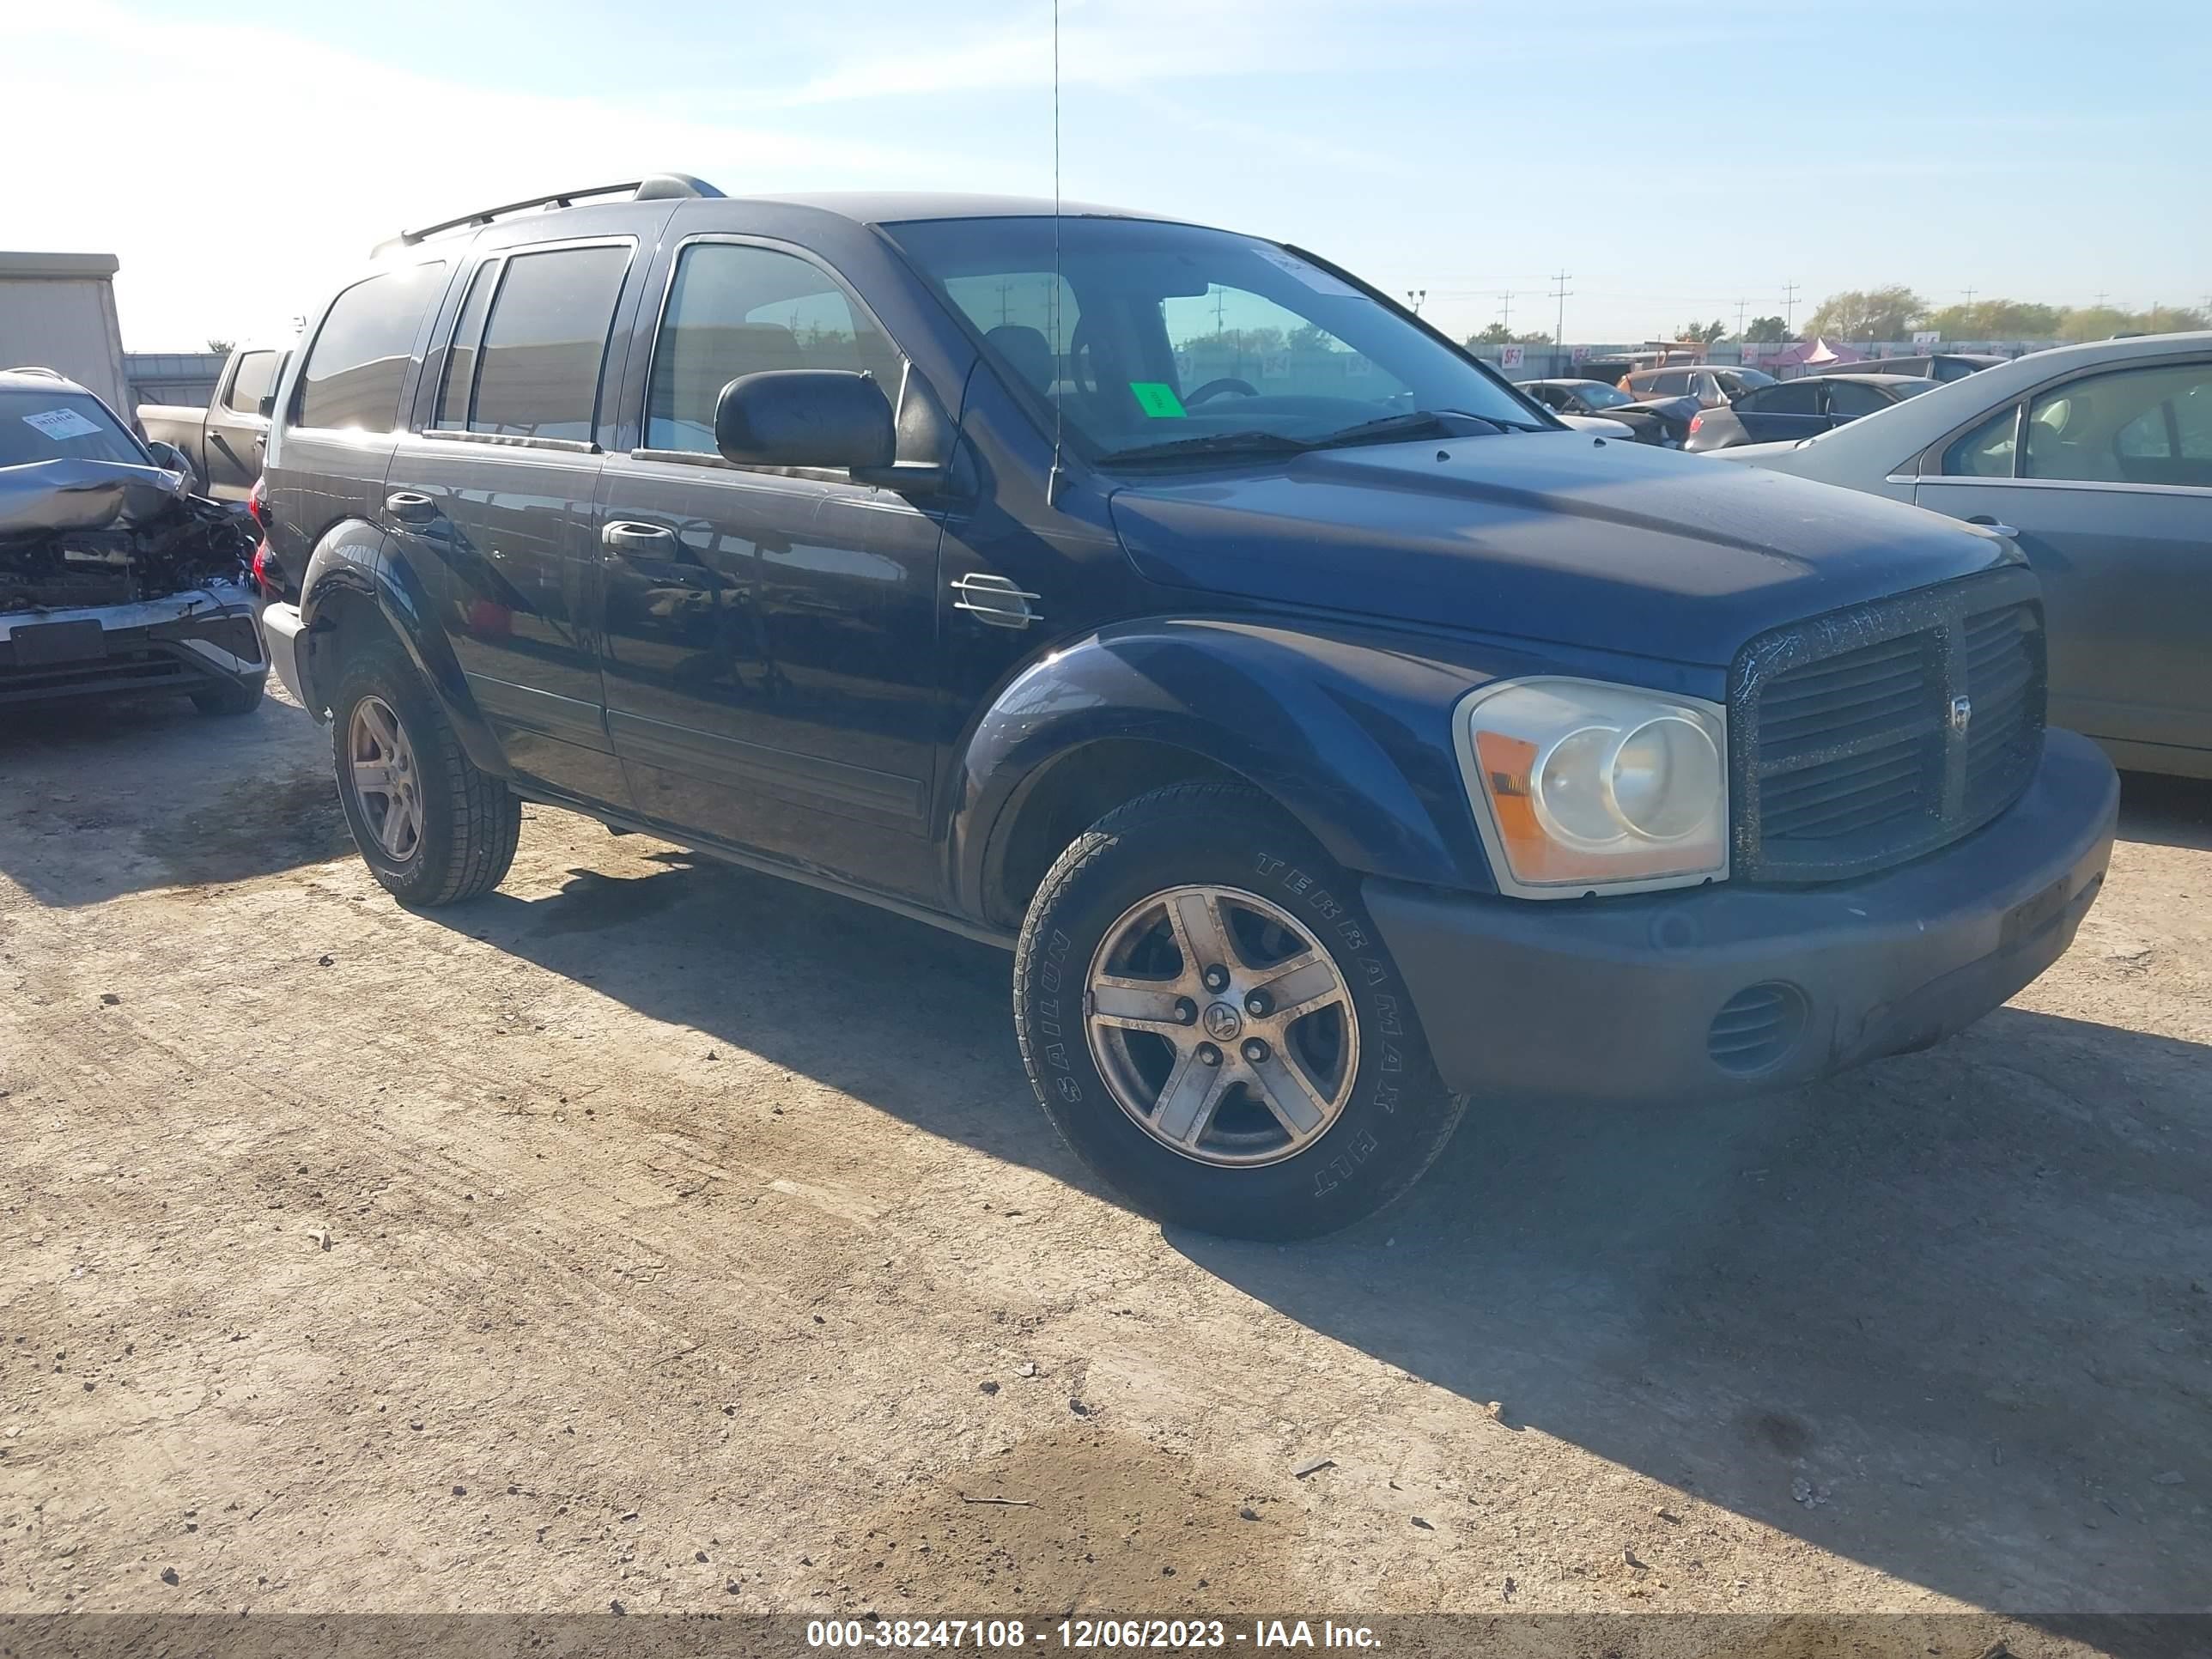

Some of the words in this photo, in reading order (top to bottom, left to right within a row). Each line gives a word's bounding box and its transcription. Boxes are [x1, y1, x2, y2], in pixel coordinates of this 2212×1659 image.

[1504, 348, 1522, 364] SF-7
[1040, 930, 1083, 1103] SAILUN
[1255, 853, 1402, 1115] TERRAMAX
